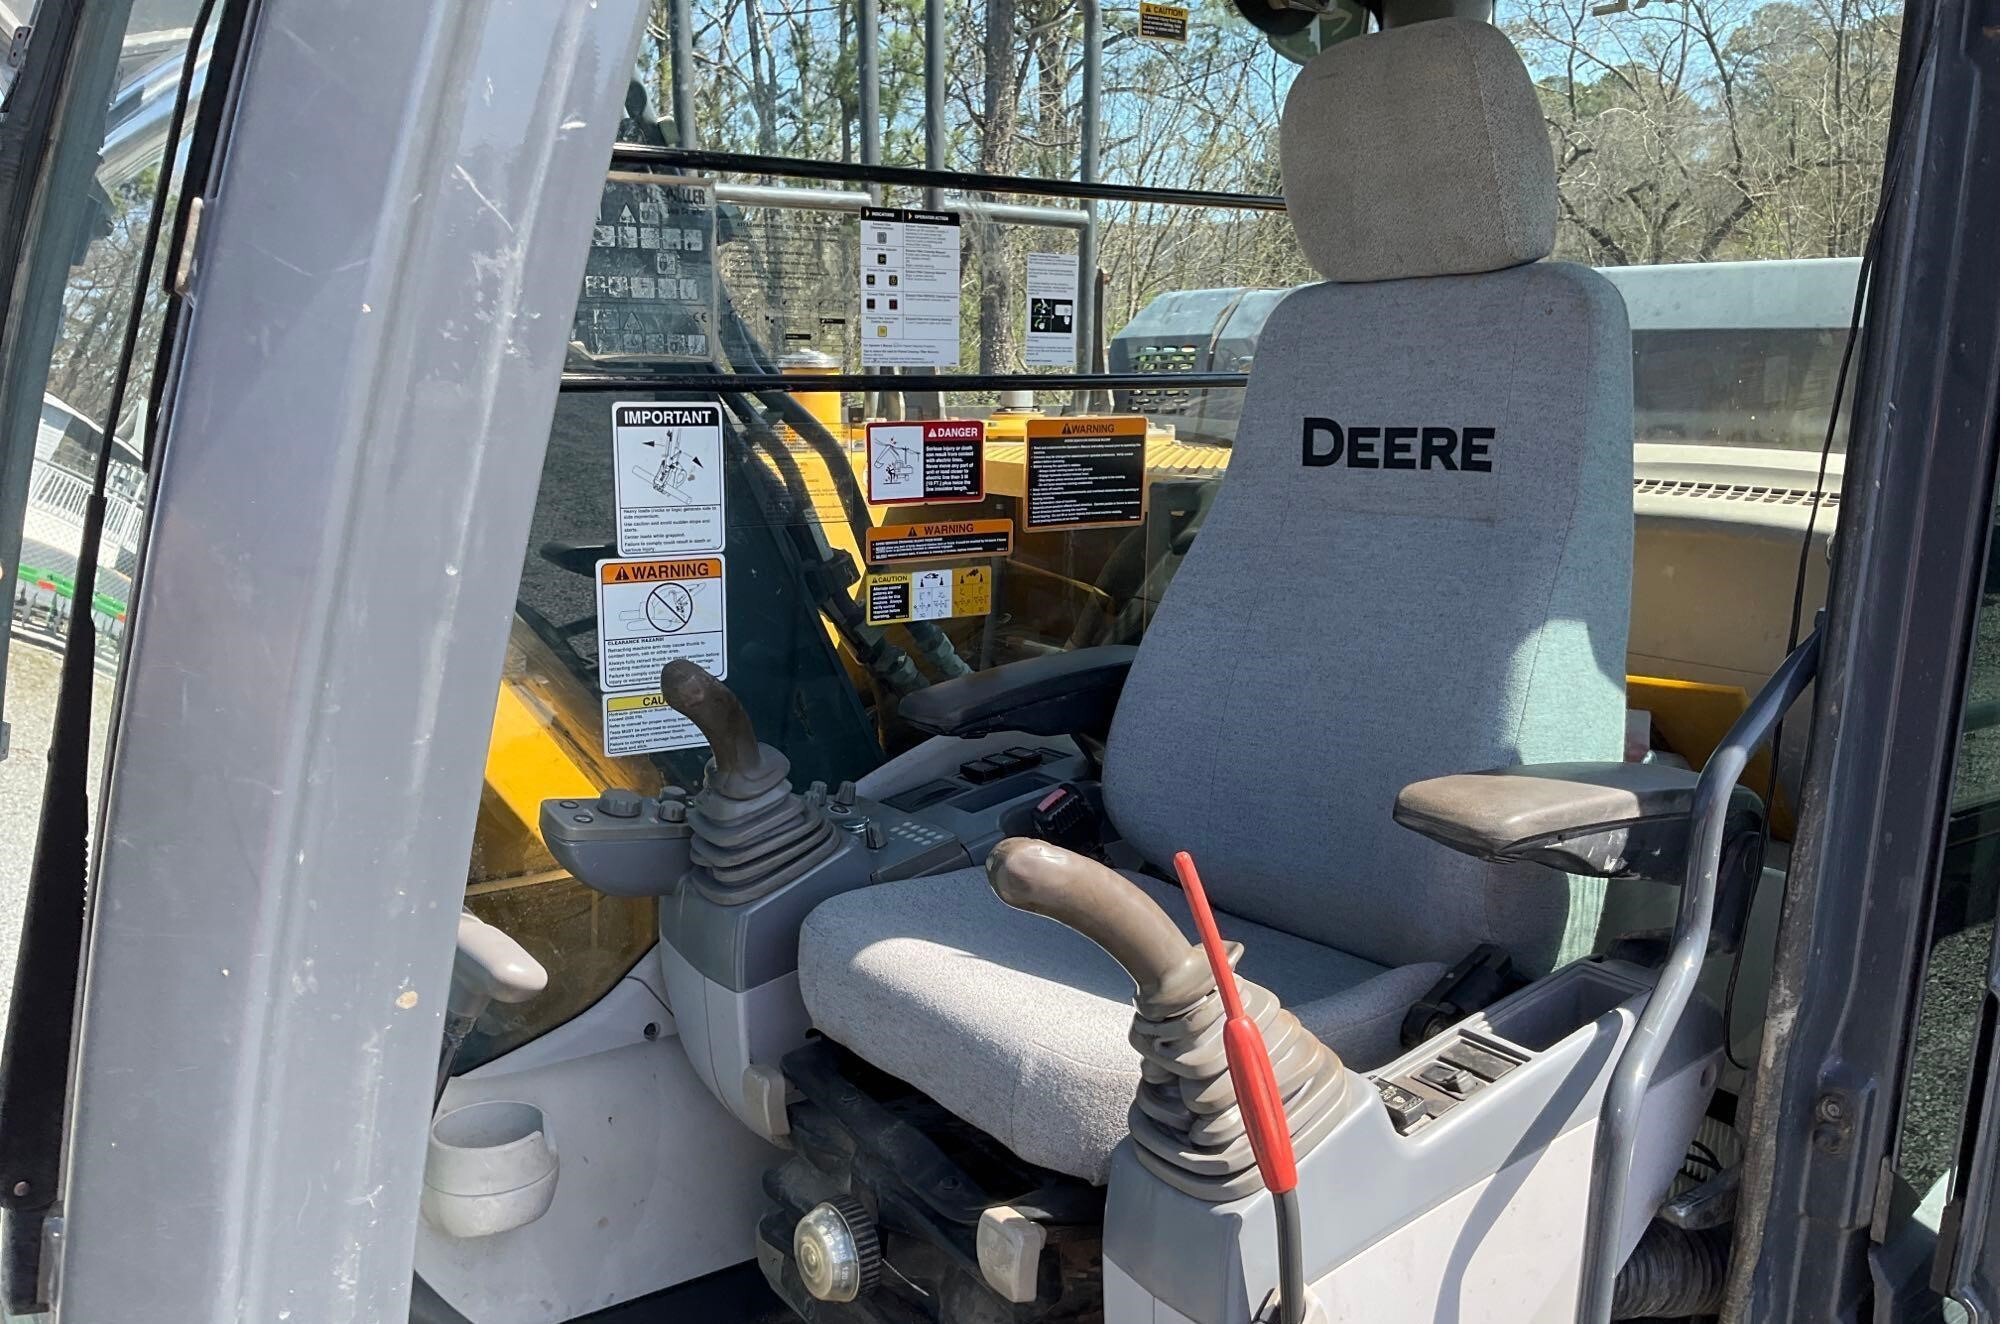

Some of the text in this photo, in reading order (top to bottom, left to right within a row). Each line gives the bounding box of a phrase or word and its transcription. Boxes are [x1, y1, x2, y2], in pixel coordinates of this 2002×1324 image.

[1154, 7, 1183, 17] CAUTION
[624, 411, 711, 424] IMPORTANT
[938, 428, 978, 437] DANGER
[1072, 424, 1114, 434] WARNING
[1302, 417, 1495, 472] DEERE
[924, 524, 973, 535] WARNING
[632, 563, 709, 579] WARNING
[879, 575, 907, 583] CAUTION
